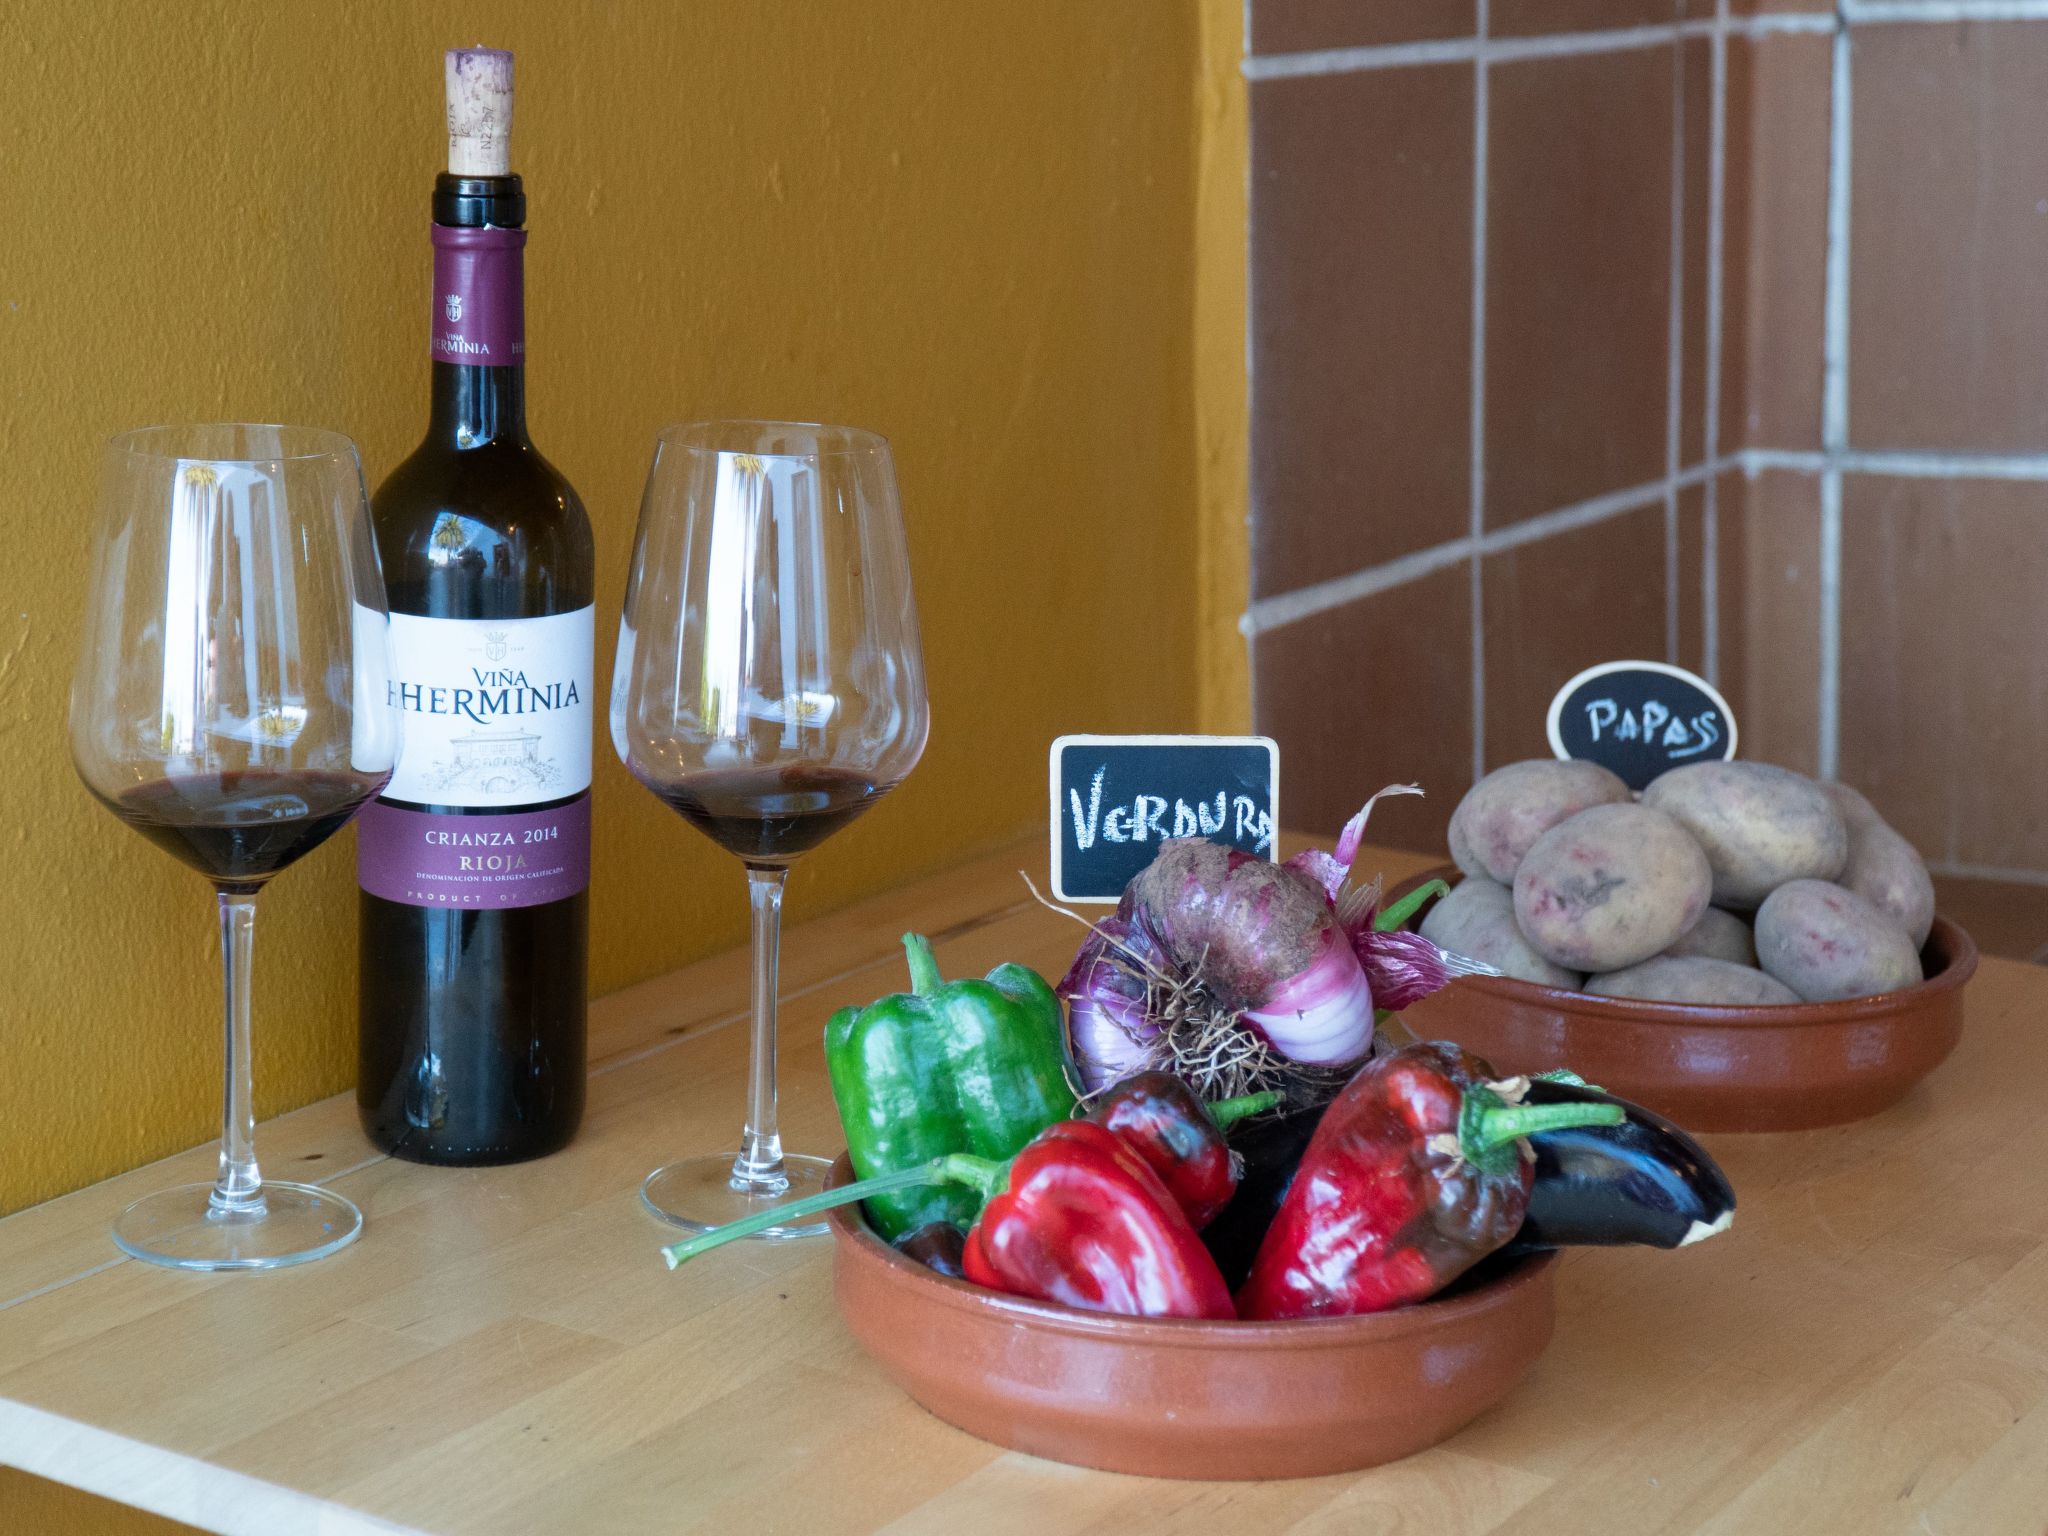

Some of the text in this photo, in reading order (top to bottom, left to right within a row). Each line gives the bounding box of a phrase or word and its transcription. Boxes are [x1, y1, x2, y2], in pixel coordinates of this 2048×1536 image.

[472, 667, 529, 689] VIÑA
[400, 680, 580, 724] HERMINIA
[1585, 698, 1720, 759] PAPAS
[425, 826, 558, 847] CRIANZA 2014
[459, 854, 528, 873] RIOJA
[494, 873, 525, 882] ORIGEN
[407, 891, 481, 903] PRODUCT
[499, 894, 518, 902] OF
